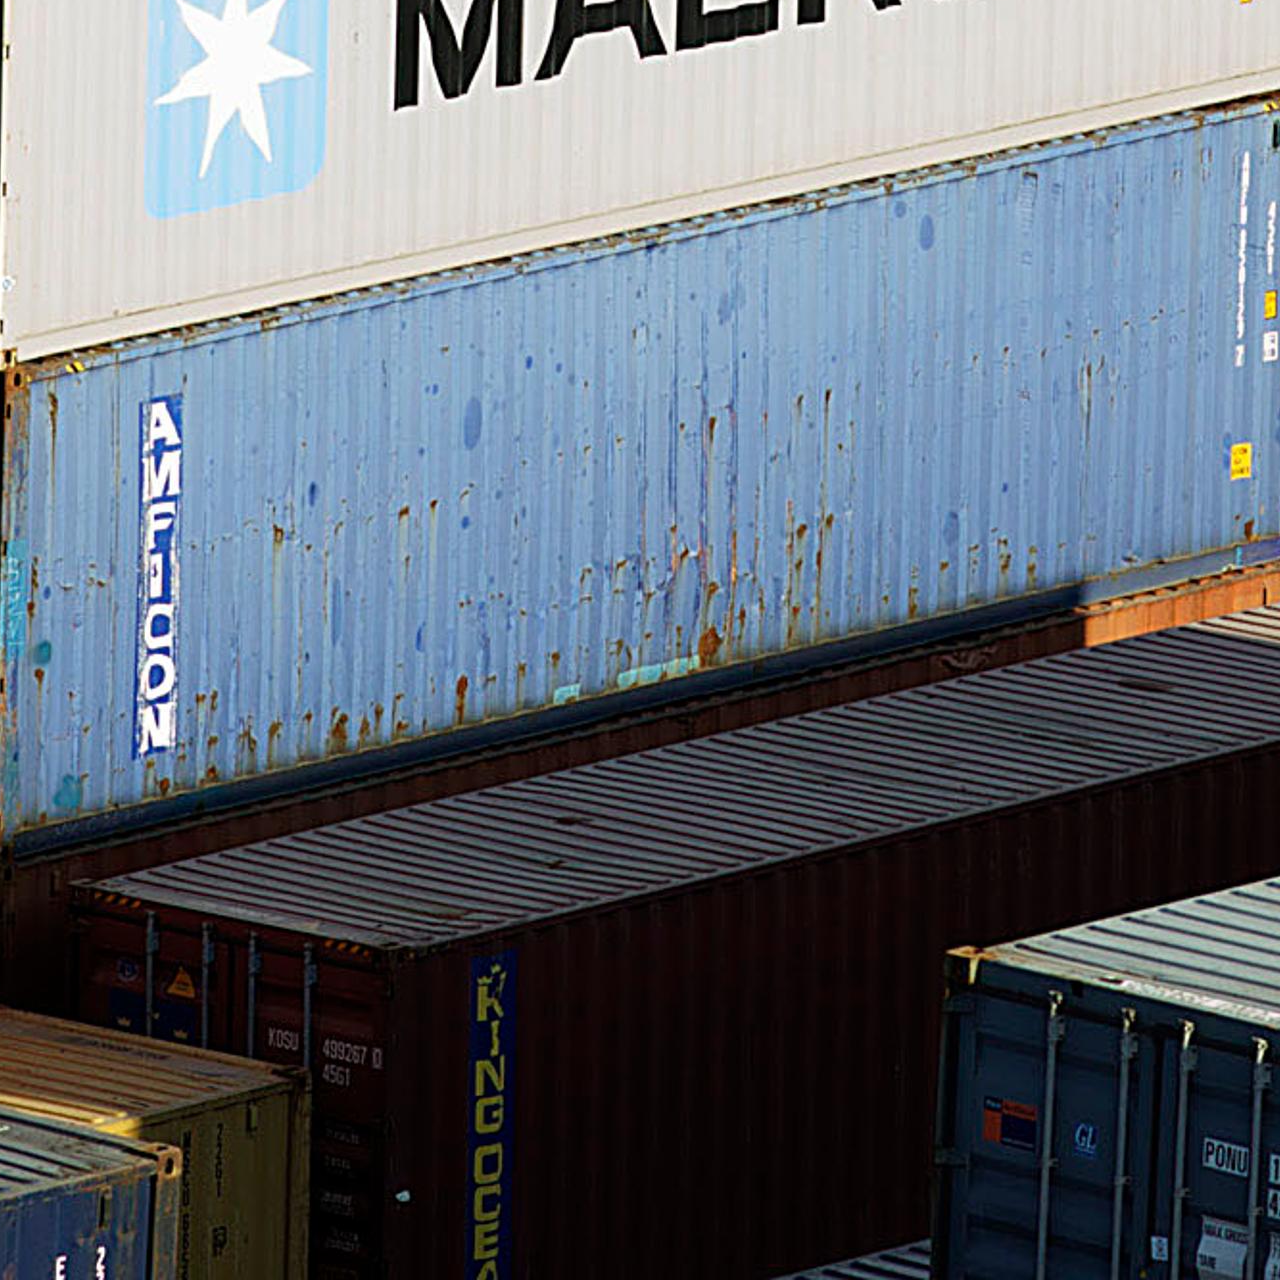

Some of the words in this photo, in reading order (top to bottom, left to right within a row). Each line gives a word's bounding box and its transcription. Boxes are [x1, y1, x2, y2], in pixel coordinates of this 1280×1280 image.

[137, 400, 183, 756] AMFICON
[267, 1026, 300, 1052] KOSU
[322, 1038, 367, 1066] 499267
[474, 970, 508, 1135] KING
[321, 1062, 351, 1088] 45G1
[1205, 1142, 1249, 1174] PONU
